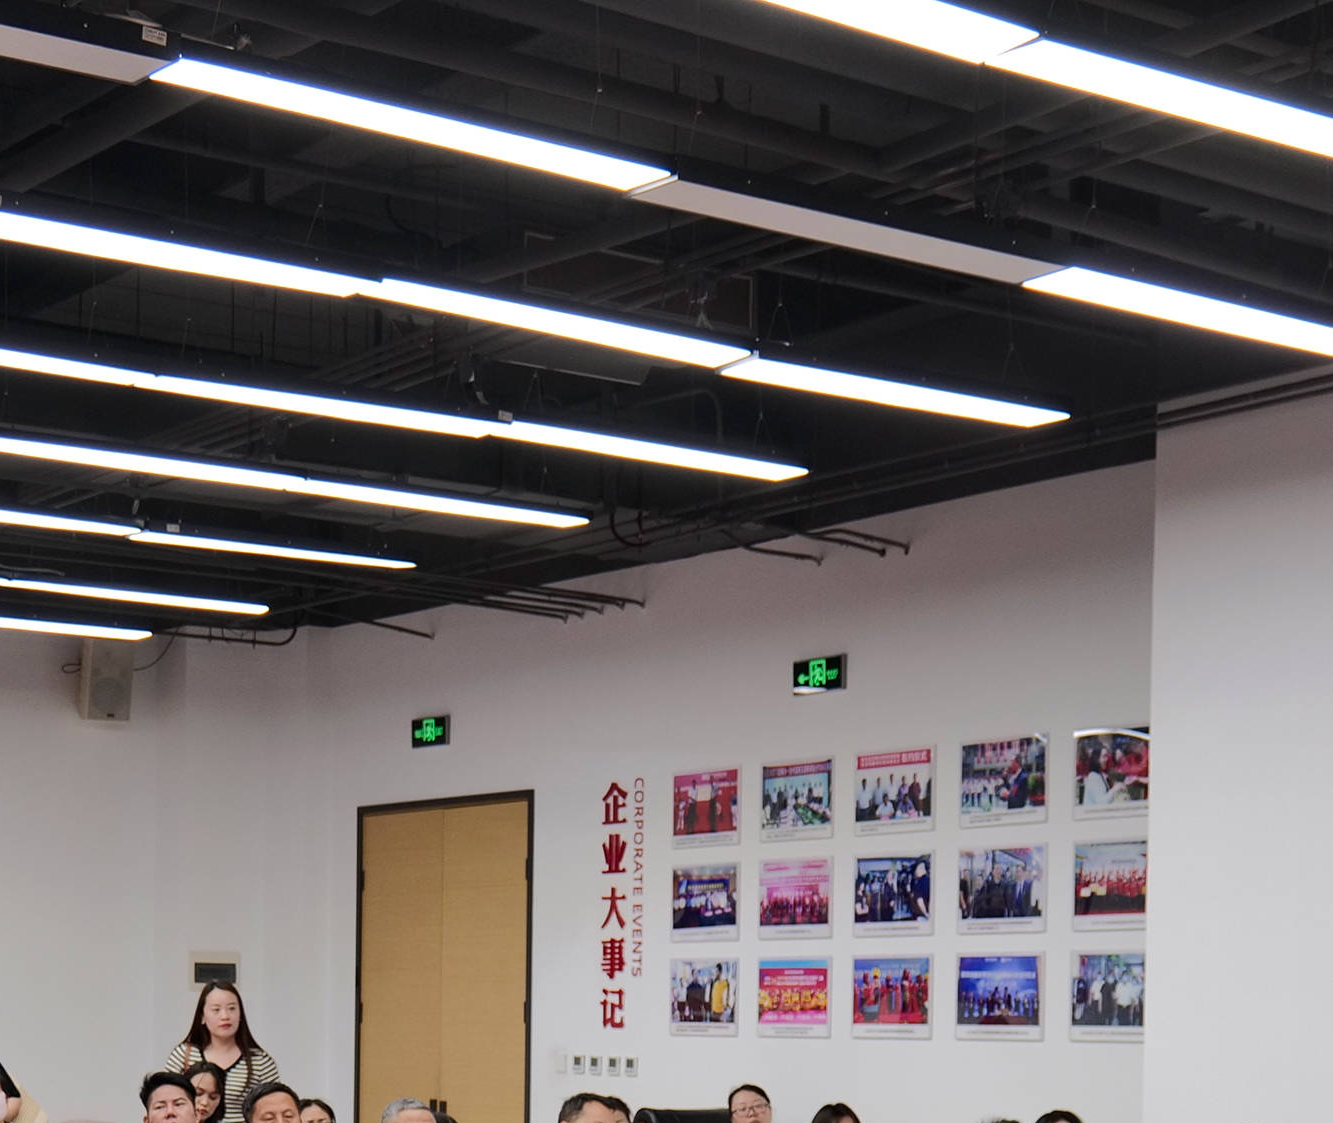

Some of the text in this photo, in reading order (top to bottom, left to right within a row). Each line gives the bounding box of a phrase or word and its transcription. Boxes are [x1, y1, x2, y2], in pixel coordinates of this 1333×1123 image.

[600, 781, 628, 1030] 企业大事记
[631, 777, 645, 978] CORPORATE EVENTS
